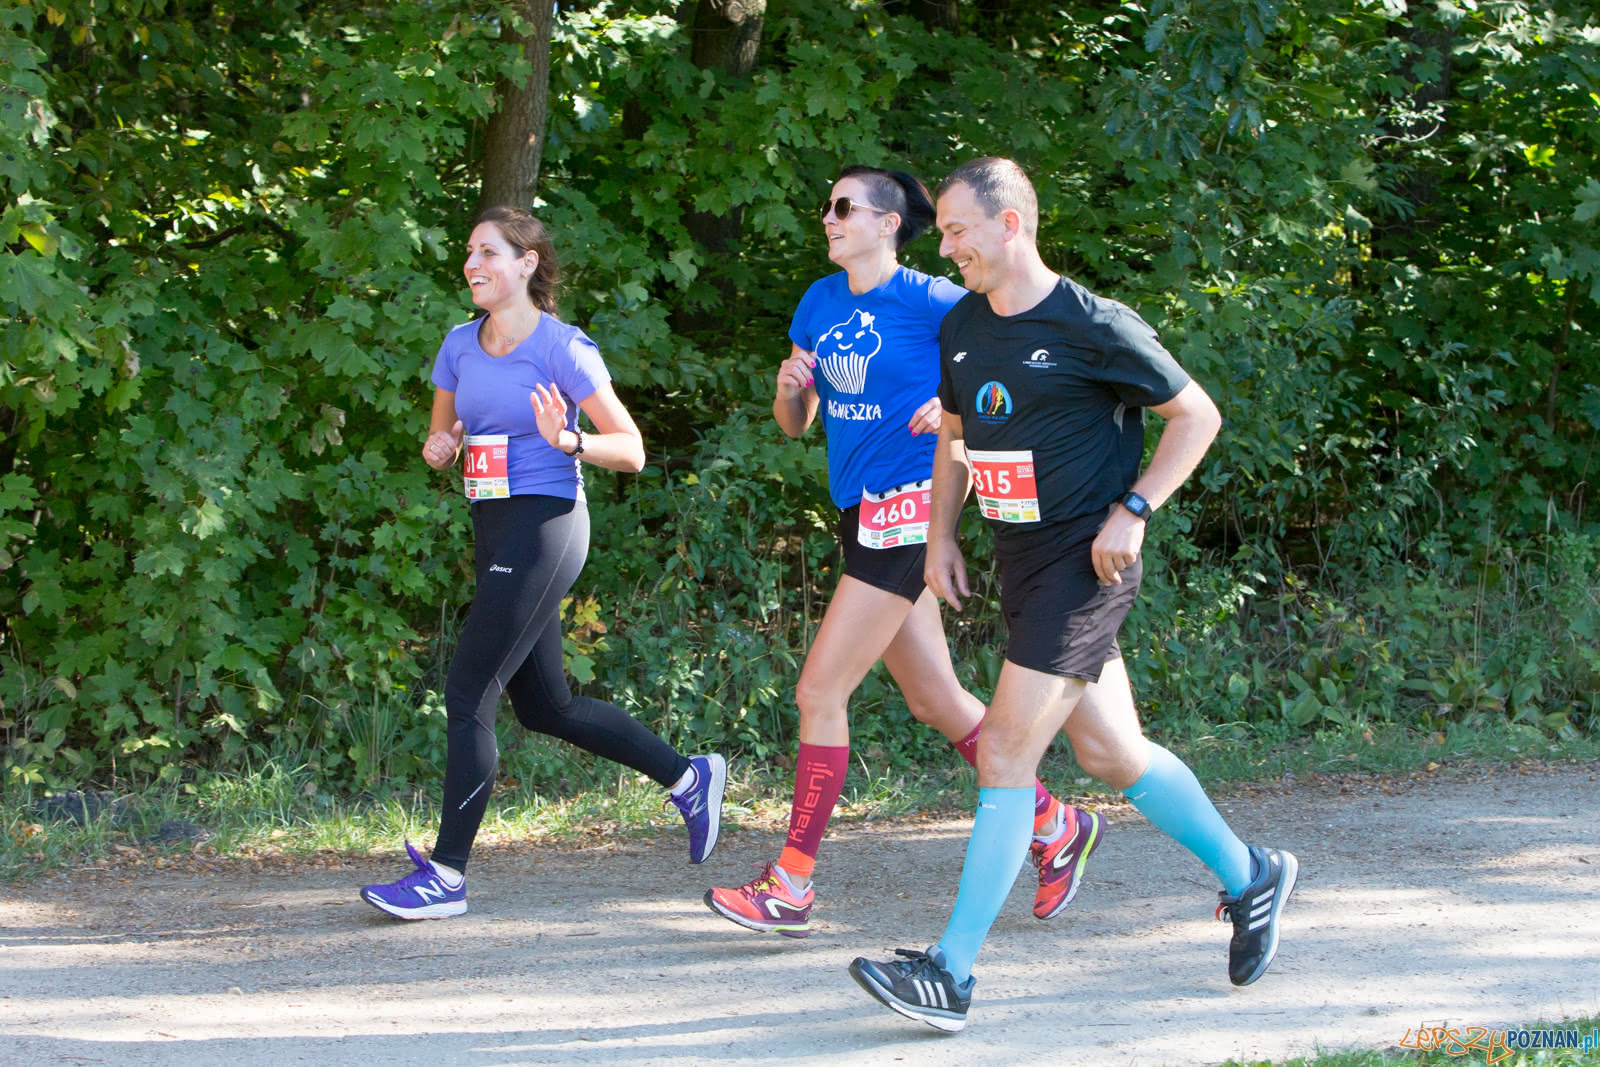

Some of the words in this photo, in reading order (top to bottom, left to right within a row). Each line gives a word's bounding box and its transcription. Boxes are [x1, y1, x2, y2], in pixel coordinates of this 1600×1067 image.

[828, 399, 882, 420] AGNIESZKA
[972, 468, 1011, 494] 315
[871, 498, 916, 526] 460
[788, 760, 835, 843] kalenji
